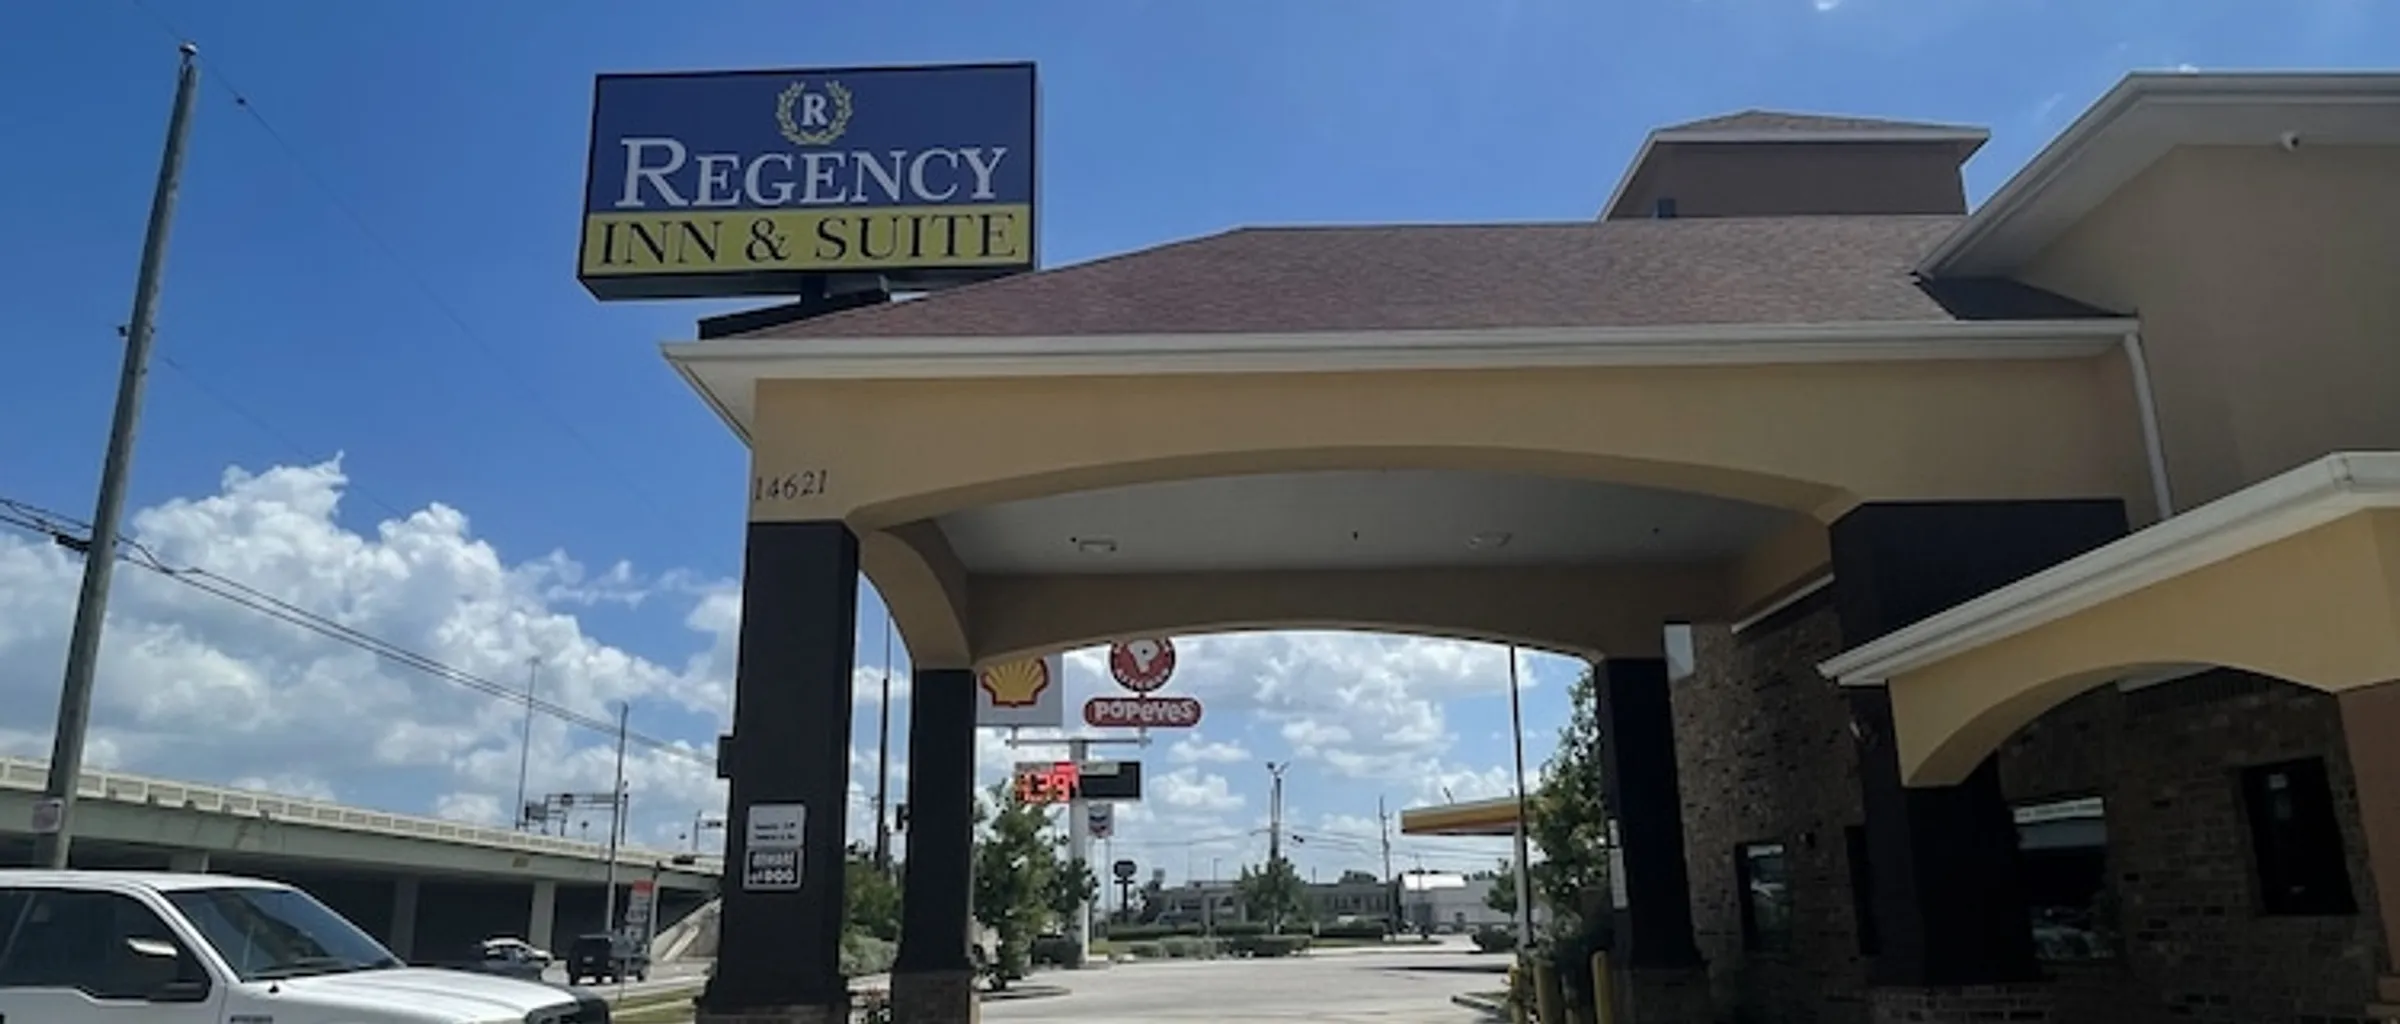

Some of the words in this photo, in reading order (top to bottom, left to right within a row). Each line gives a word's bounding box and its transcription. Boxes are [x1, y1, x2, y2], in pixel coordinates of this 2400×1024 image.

[802, 93, 829, 127] R
[615, 137, 1008, 208] REGENCY
[601, 220, 722, 266] INN
[745, 217, 791, 263] &
[815, 213, 1016, 261] SUITE
[755, 468, 827, 501] 14621
